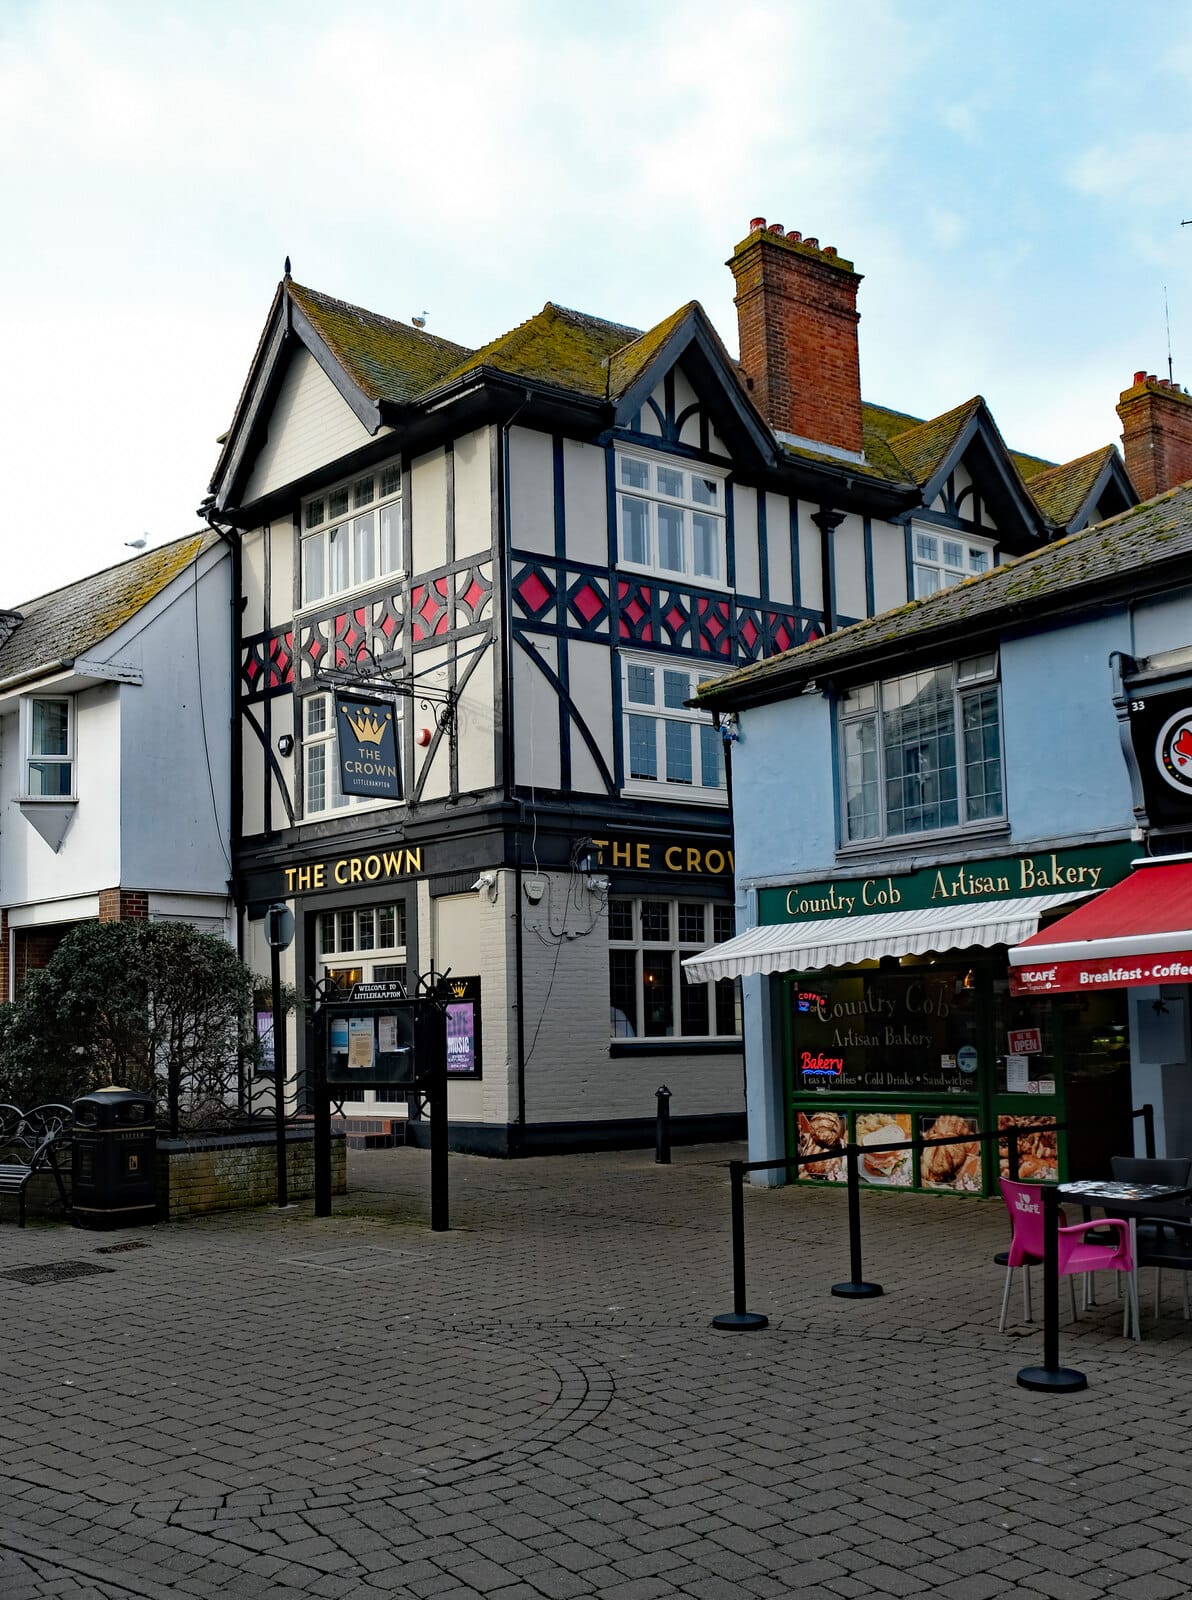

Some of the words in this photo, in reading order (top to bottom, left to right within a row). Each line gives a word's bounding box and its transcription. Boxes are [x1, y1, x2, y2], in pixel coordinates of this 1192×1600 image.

[1131, 701, 1146, 711] 33
[358, 748, 381, 761] THE
[344, 761, 396, 777] CROWN
[592, 839, 650, 868] THE
[284, 863, 325, 892] THE
[334, 847, 422, 884] CROWN
[786, 884, 856, 915] Country
[862, 878, 901, 907] Cob
[931, 865, 1011, 899] Artisan
[1019, 854, 1103, 888] Bakery
[1079, 968, 1142, 984] Breakfast
[354, 991, 401, 1000] LITTLEHAMPTON
[358, 984, 387, 992] WELCOME
[816, 984, 897, 1022] Country
[906, 982, 950, 1018] Cob
[447, 1036, 470, 1054] MUSIC
[832, 1027, 880, 1048] Artisan
[885, 1025, 934, 1049] Bakery
[1014, 1039, 1038, 1051] OPEN
[801, 1051, 843, 1075] Bakery
[803, 1074, 820, 1085] Teas
[828, 1073, 857, 1085] Coffees
[864, 1072, 884, 1085] Cold
[887, 1072, 914, 1085] Drinks
[922, 1072, 974, 1086] Sandwiches
